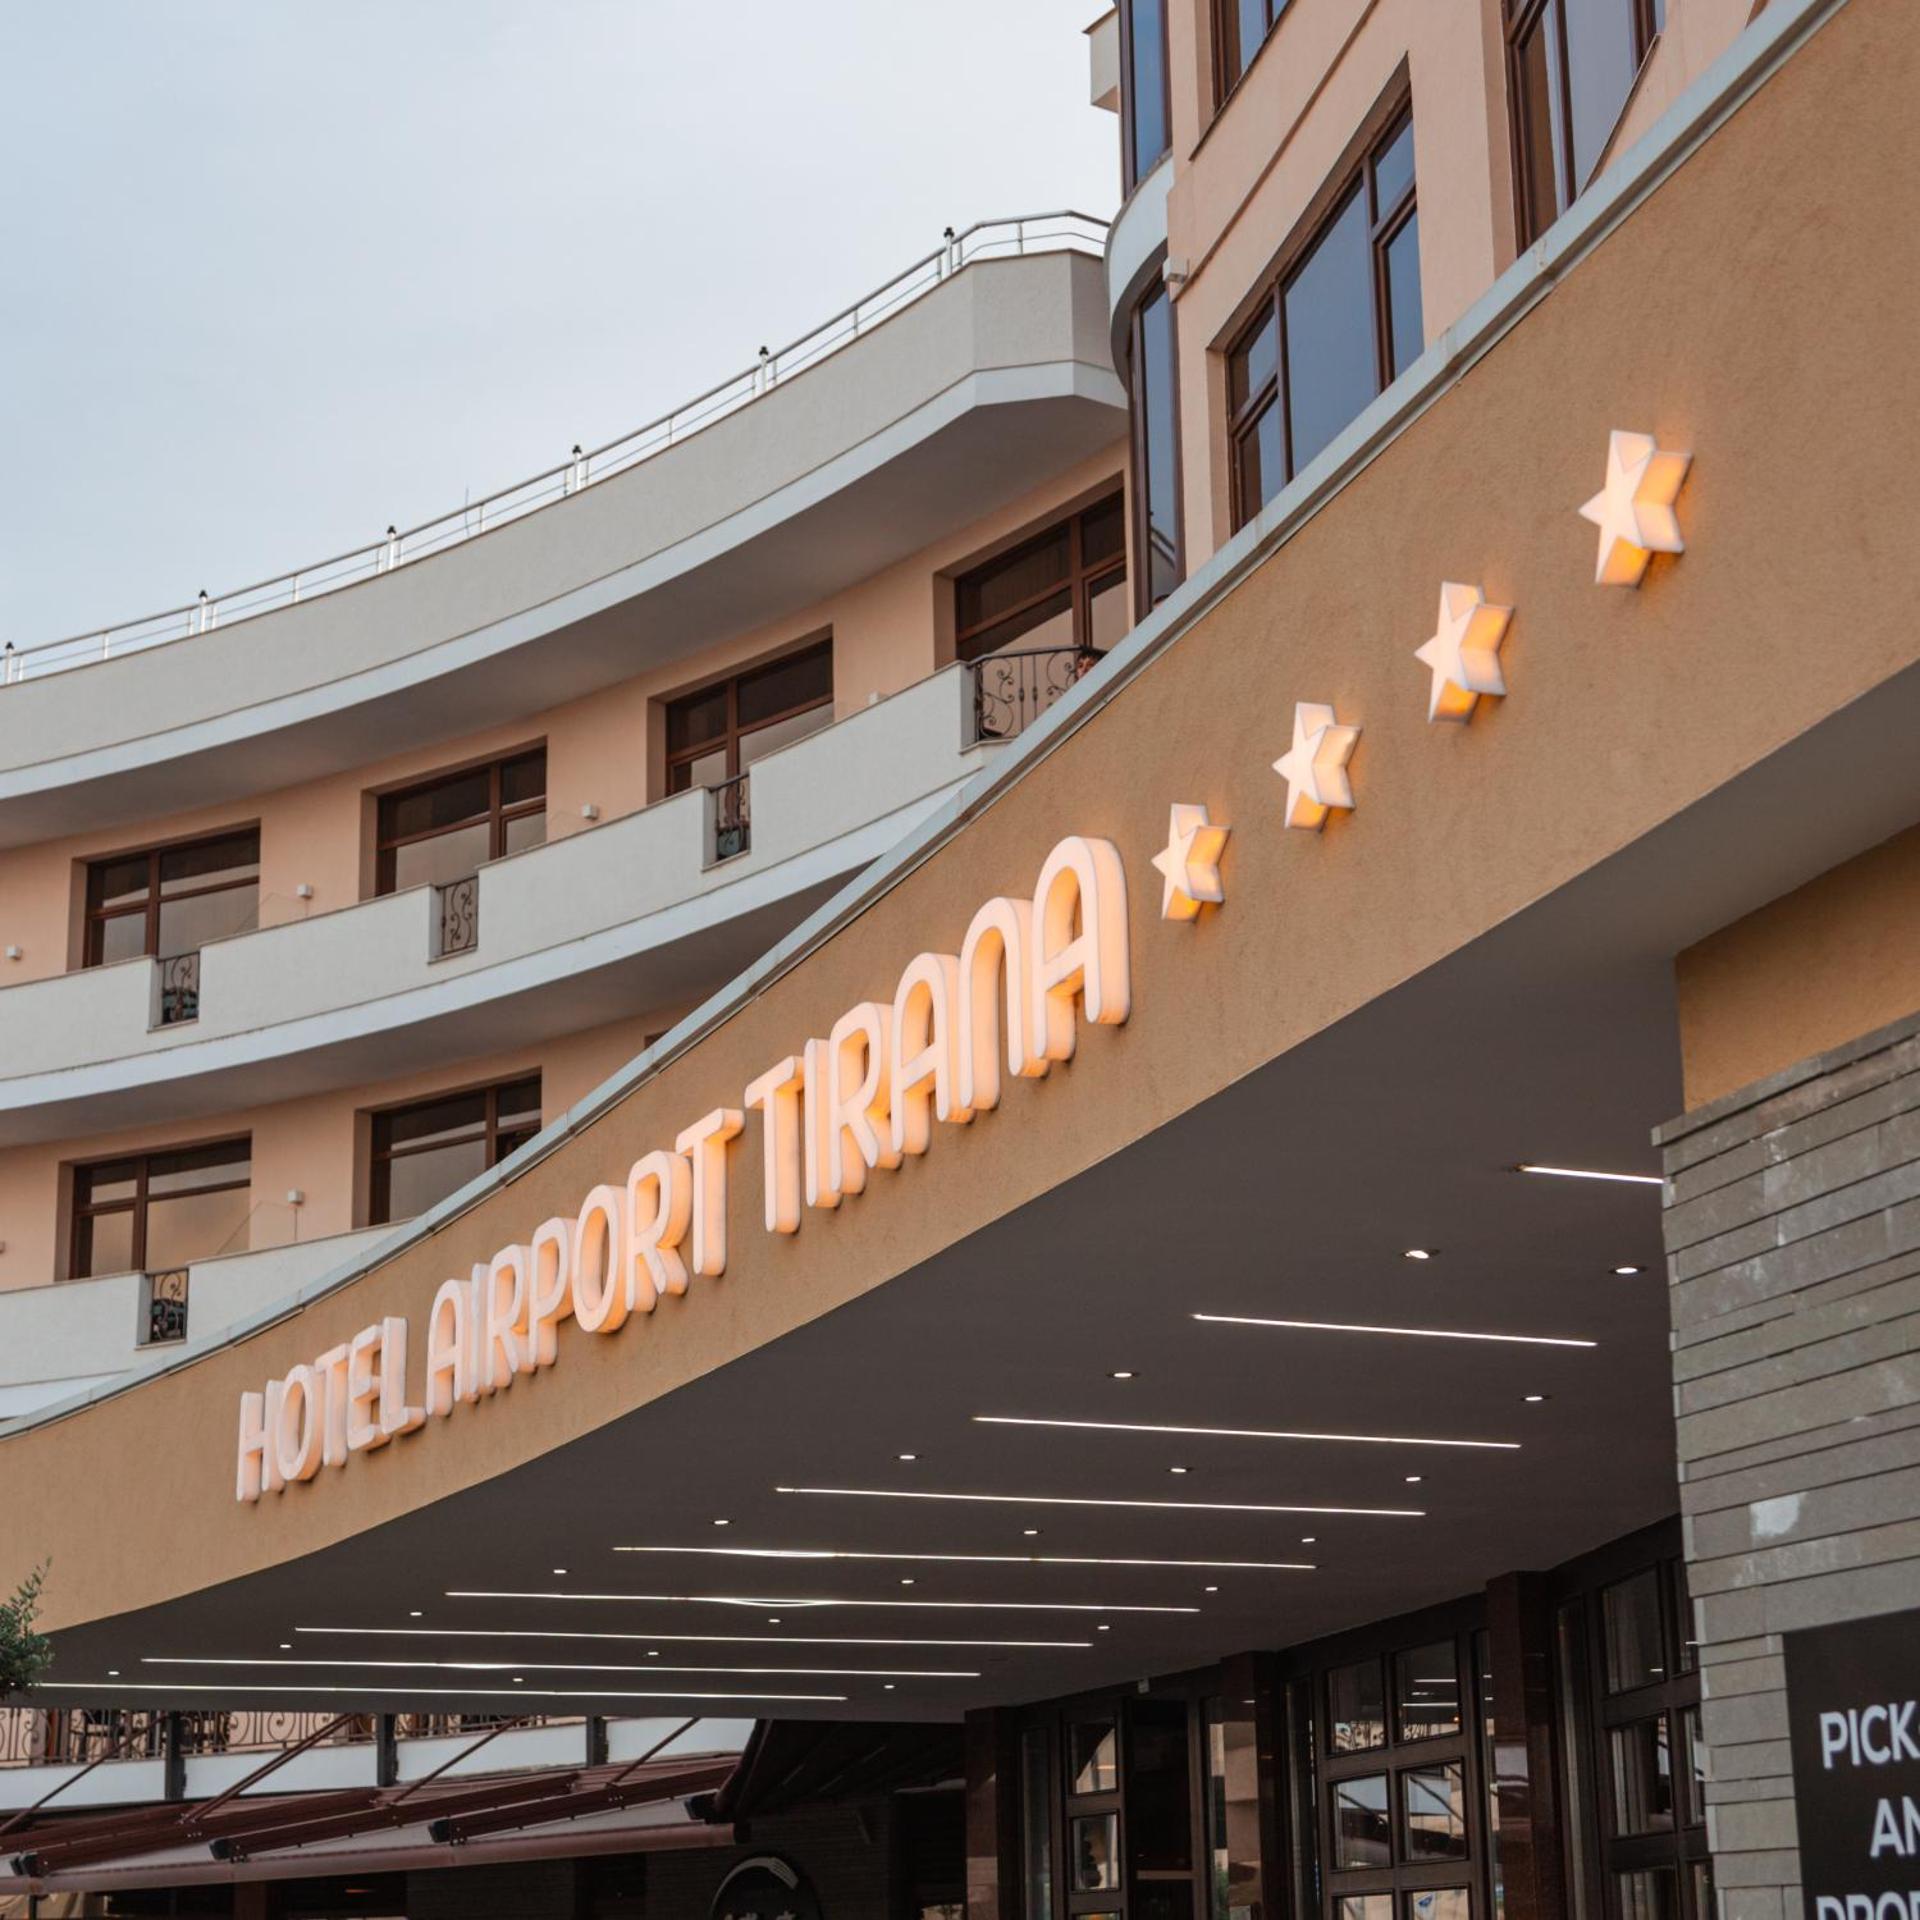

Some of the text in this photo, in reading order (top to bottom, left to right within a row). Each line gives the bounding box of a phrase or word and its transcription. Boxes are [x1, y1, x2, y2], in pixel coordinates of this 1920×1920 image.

[237, 836, 1131, 1502] HOTEL AIRPORT TIRANA
[1820, 1700, 1920, 1769] PICK
